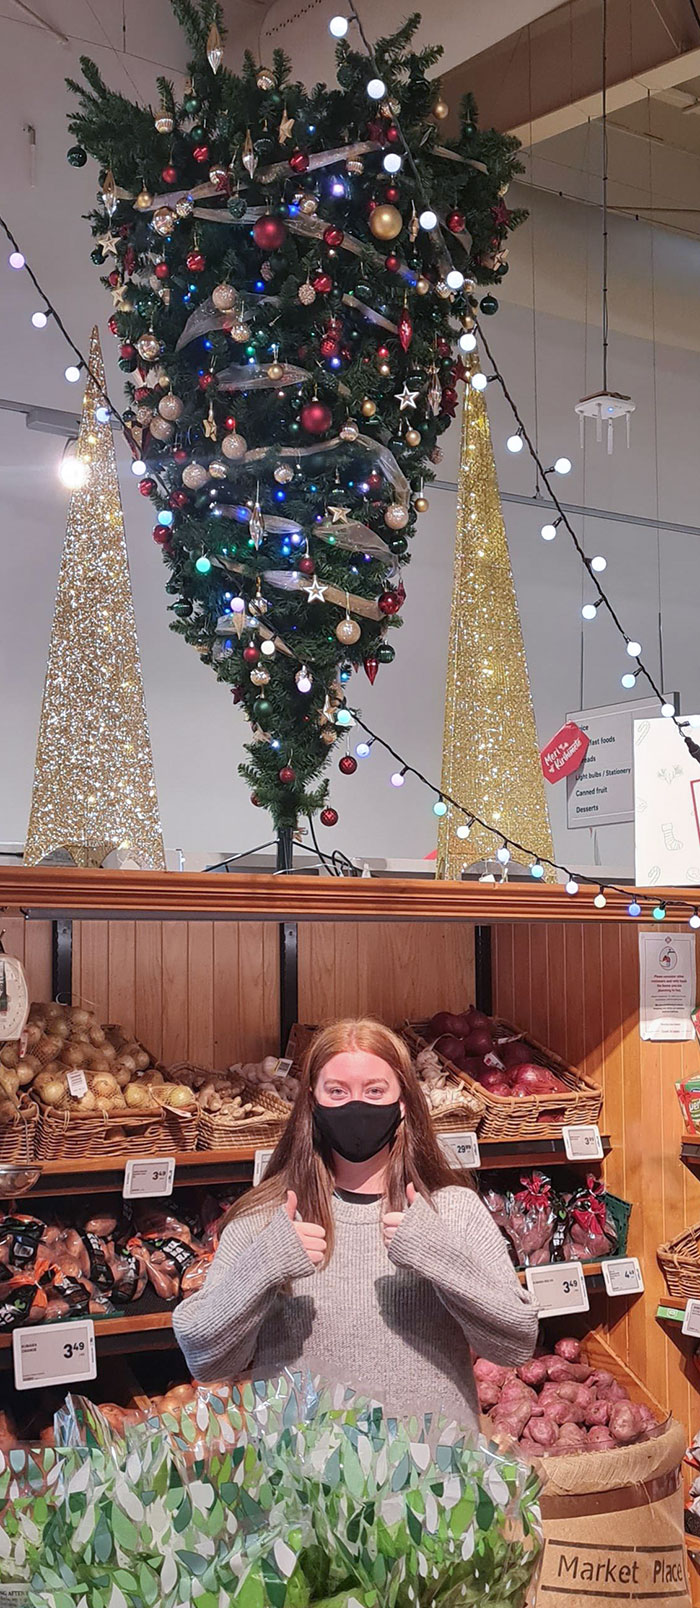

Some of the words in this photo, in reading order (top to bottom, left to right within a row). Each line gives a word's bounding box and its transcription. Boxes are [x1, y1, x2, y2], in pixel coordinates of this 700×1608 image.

[600, 736, 616, 744] foods
[544, 747, 560, 766] Meri
[575, 772, 588, 782] Light
[588, 771, 602, 779] bulbs
[605, 767, 632, 777] Stationery
[575, 788, 596, 797] Canned
[596, 786, 608, 794] fruit
[576, 805, 599, 814] Desserts
[562, 1279, 578, 1294] 349
[63, 1341, 85, 1359] 349
[557, 1553, 640, 1584] Market
[652, 1557, 683, 1584] Place
